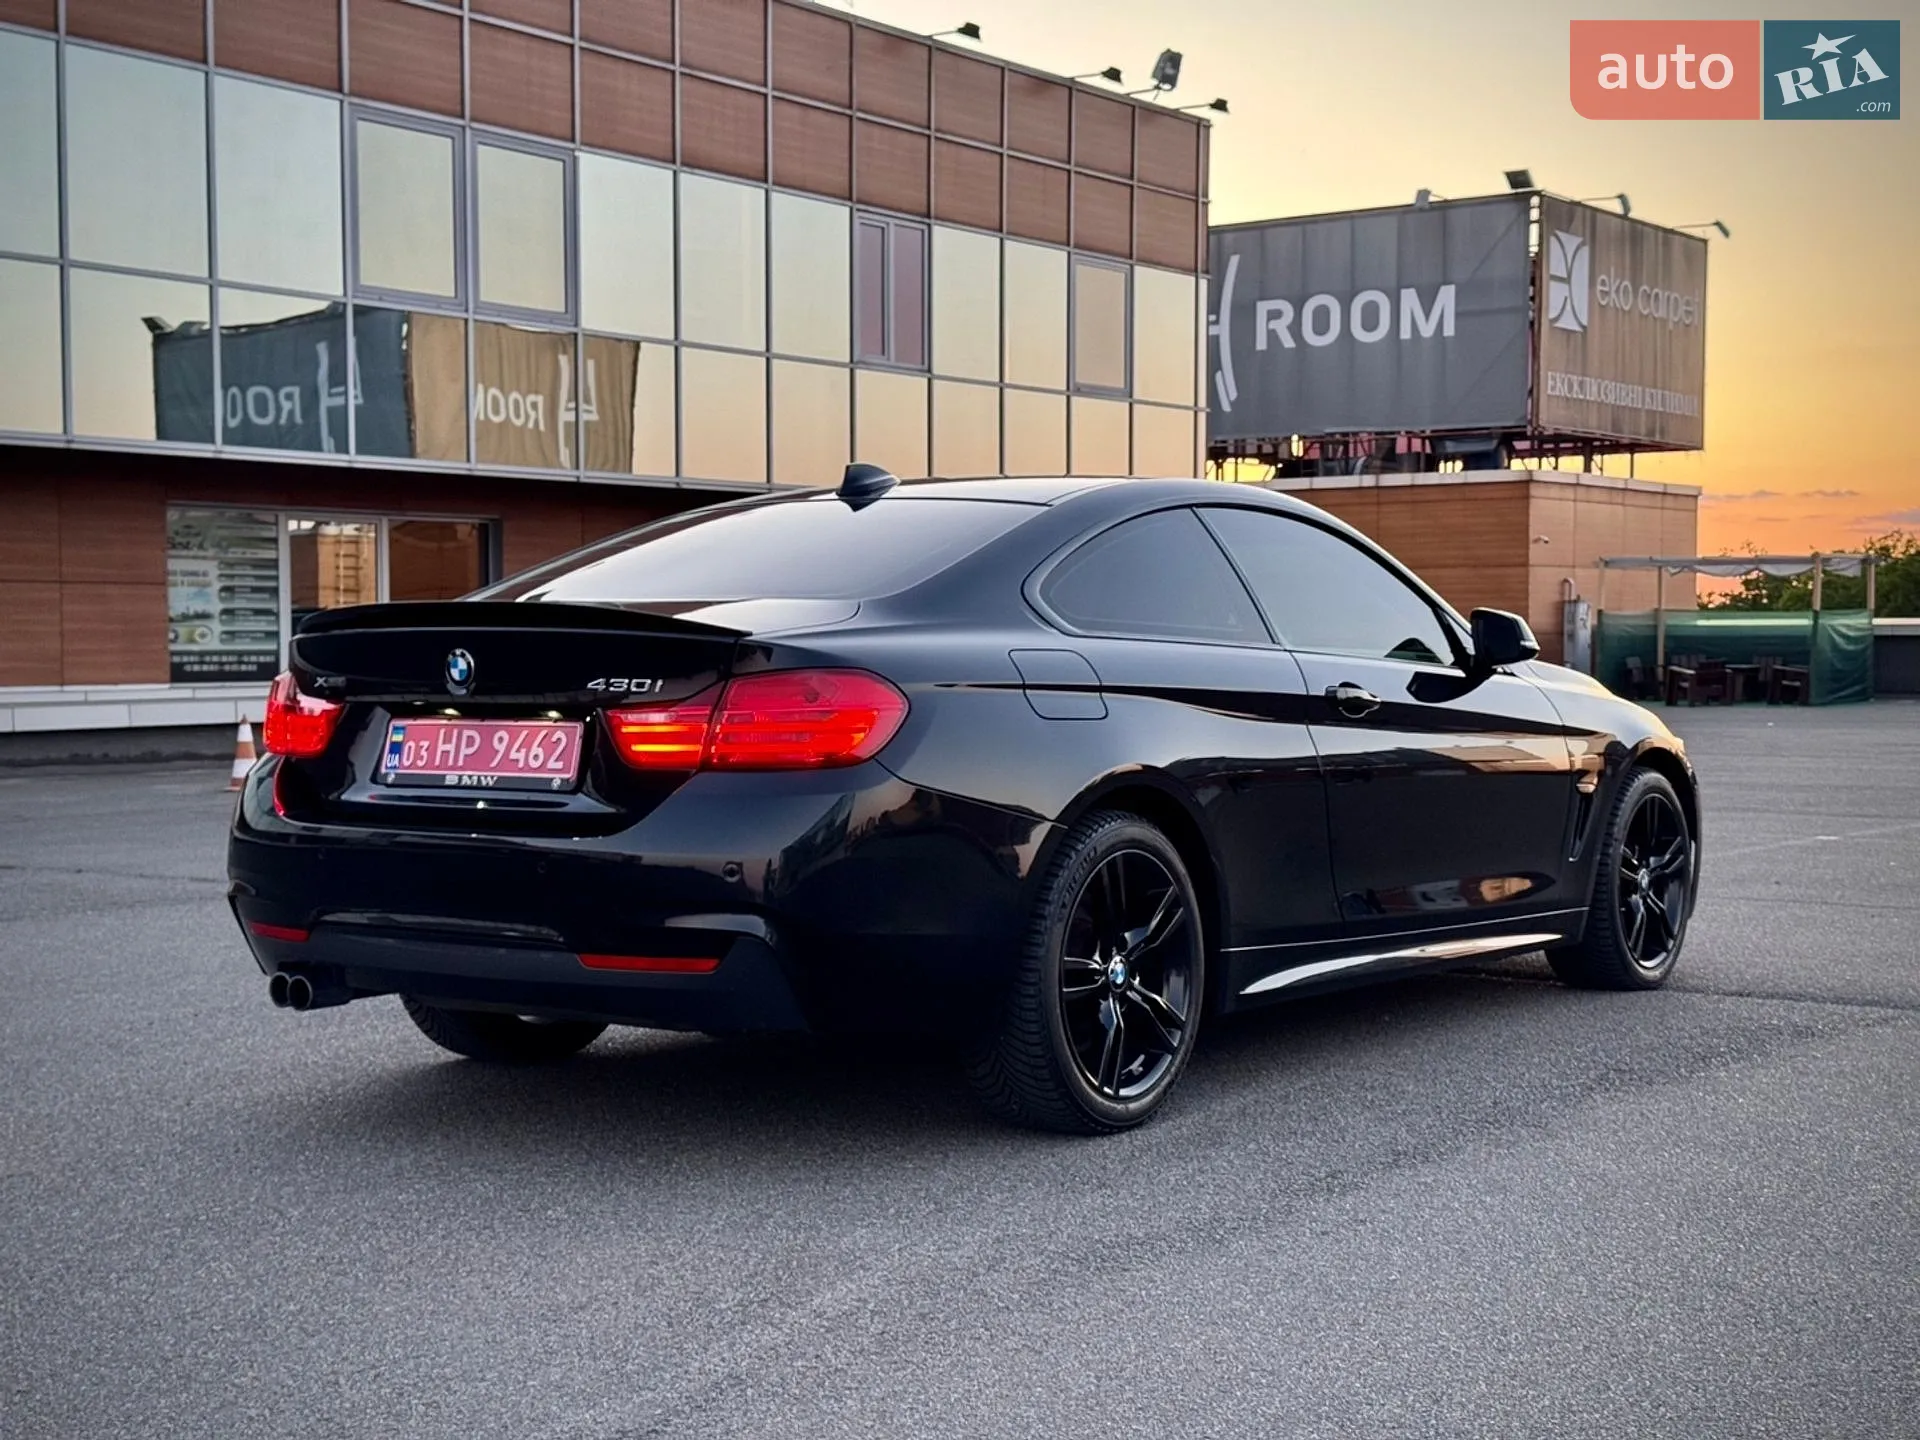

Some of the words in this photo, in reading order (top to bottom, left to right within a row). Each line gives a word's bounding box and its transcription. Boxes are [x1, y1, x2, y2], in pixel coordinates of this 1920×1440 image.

[1596, 267, 1633, 312] eko
[1254, 284, 1456, 350] ROOM
[387, 753, 400, 768] UA
[402, 740, 431, 767] 03
[434, 728, 481, 767] HP
[489, 729, 568, 770] 9462
[444, 774, 498, 787] BMW
